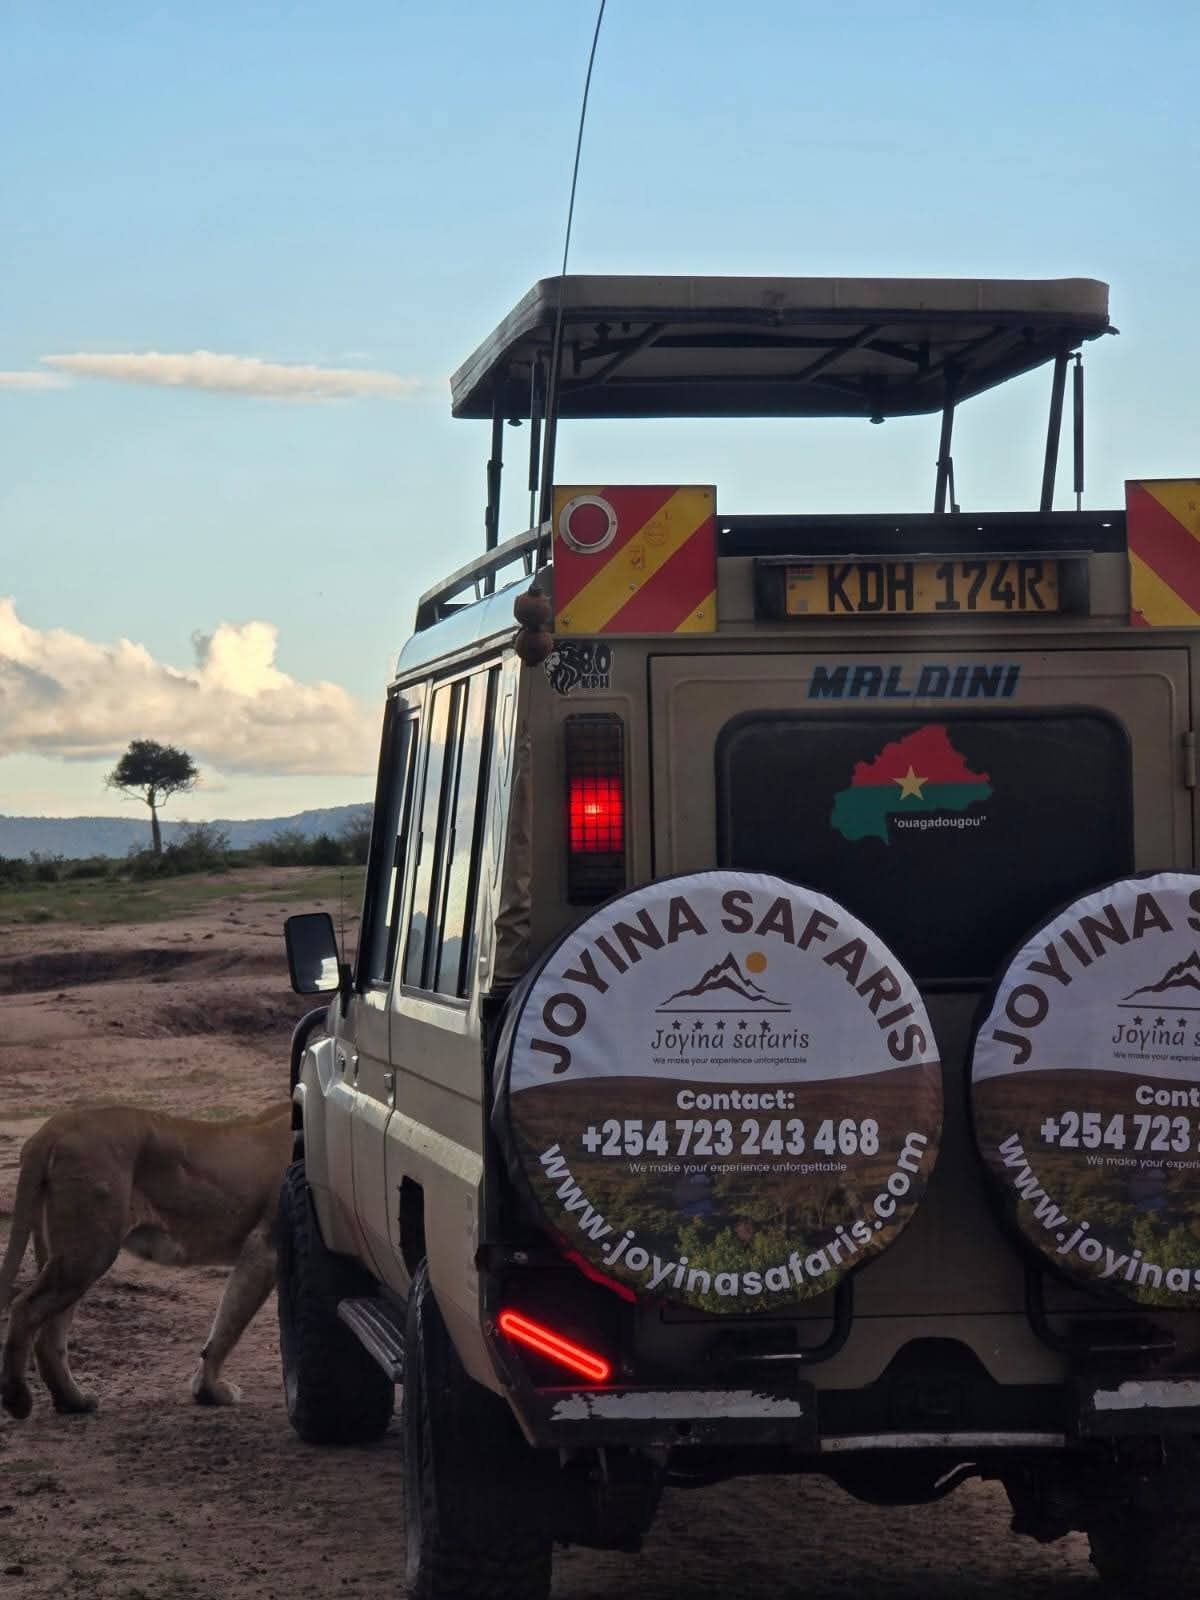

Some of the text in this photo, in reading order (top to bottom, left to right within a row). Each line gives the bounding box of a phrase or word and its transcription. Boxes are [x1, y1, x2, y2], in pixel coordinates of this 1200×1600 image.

[827, 560, 1045, 612] KDH 174R
[807, 664, 1021, 699] MALDINI
[530, 889, 928, 1074] JOYINA SAFARIS
[992, 892, 1173, 1065] JOYINA
[651, 1026, 809, 1055] Joyina safaris
[1112, 1024, 1185, 1051] Joyina
[676, 1089, 796, 1110] Contact:
[582, 1118, 880, 1156] +254 723 243 468
[1041, 1111, 1126, 1150] +254
[1133, 1114, 1191, 1152] 723
[629, 1162, 847, 1176] We make your experience unforgettable
[1086, 1155, 1104, 1166] We
[1106, 1156, 1136, 1168] make
[1140, 1158, 1164, 1169] your
[538, 1131, 928, 1297] www.joyinasafaris.com
